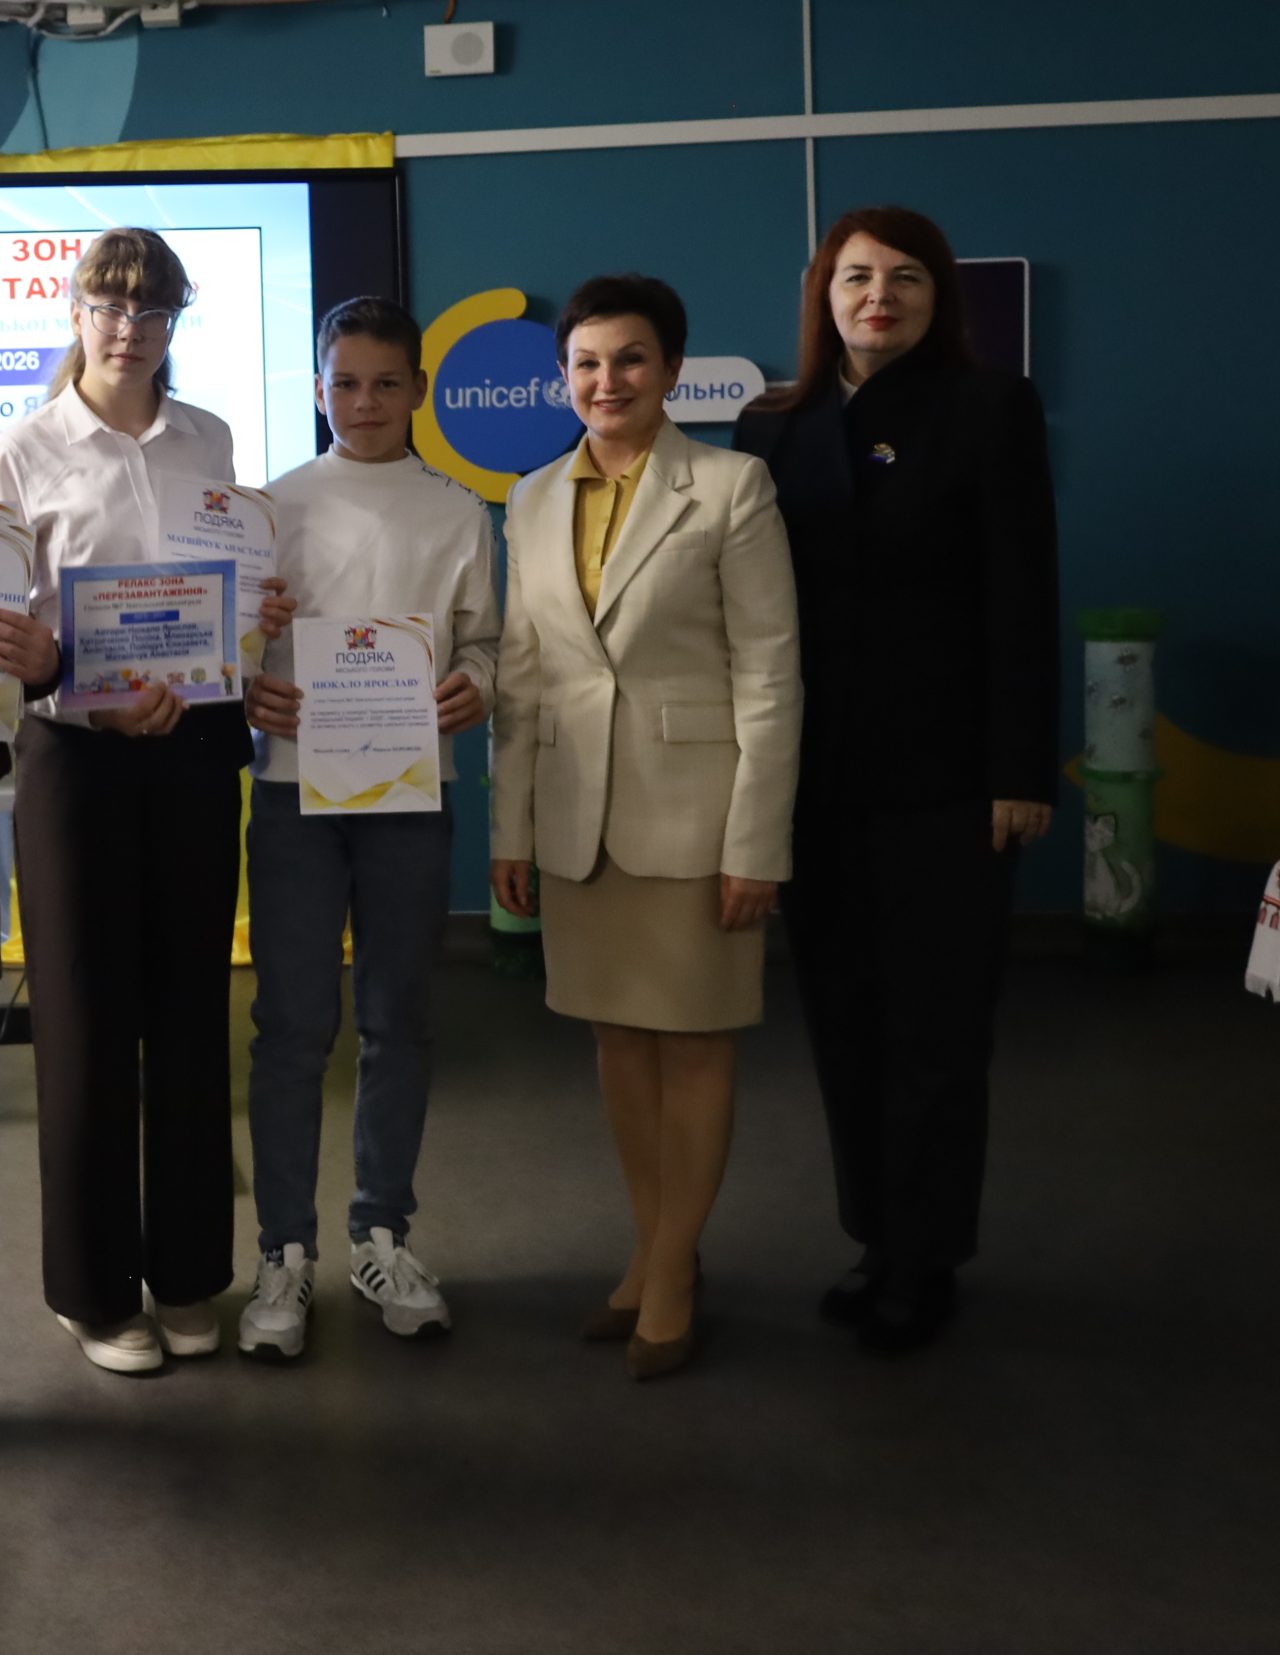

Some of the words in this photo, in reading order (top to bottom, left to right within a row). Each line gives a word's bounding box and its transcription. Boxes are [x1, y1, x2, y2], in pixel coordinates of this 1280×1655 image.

[12, 238, 82, 262] ЗОН
[445, 378, 540, 408] unicef
[673, 382, 745, 401] льно
[193, 511, 245, 530] ПОДЯКА
[160, 576, 185, 586] ЗОНА
[335, 651, 395, 665] ПОДЯКА
